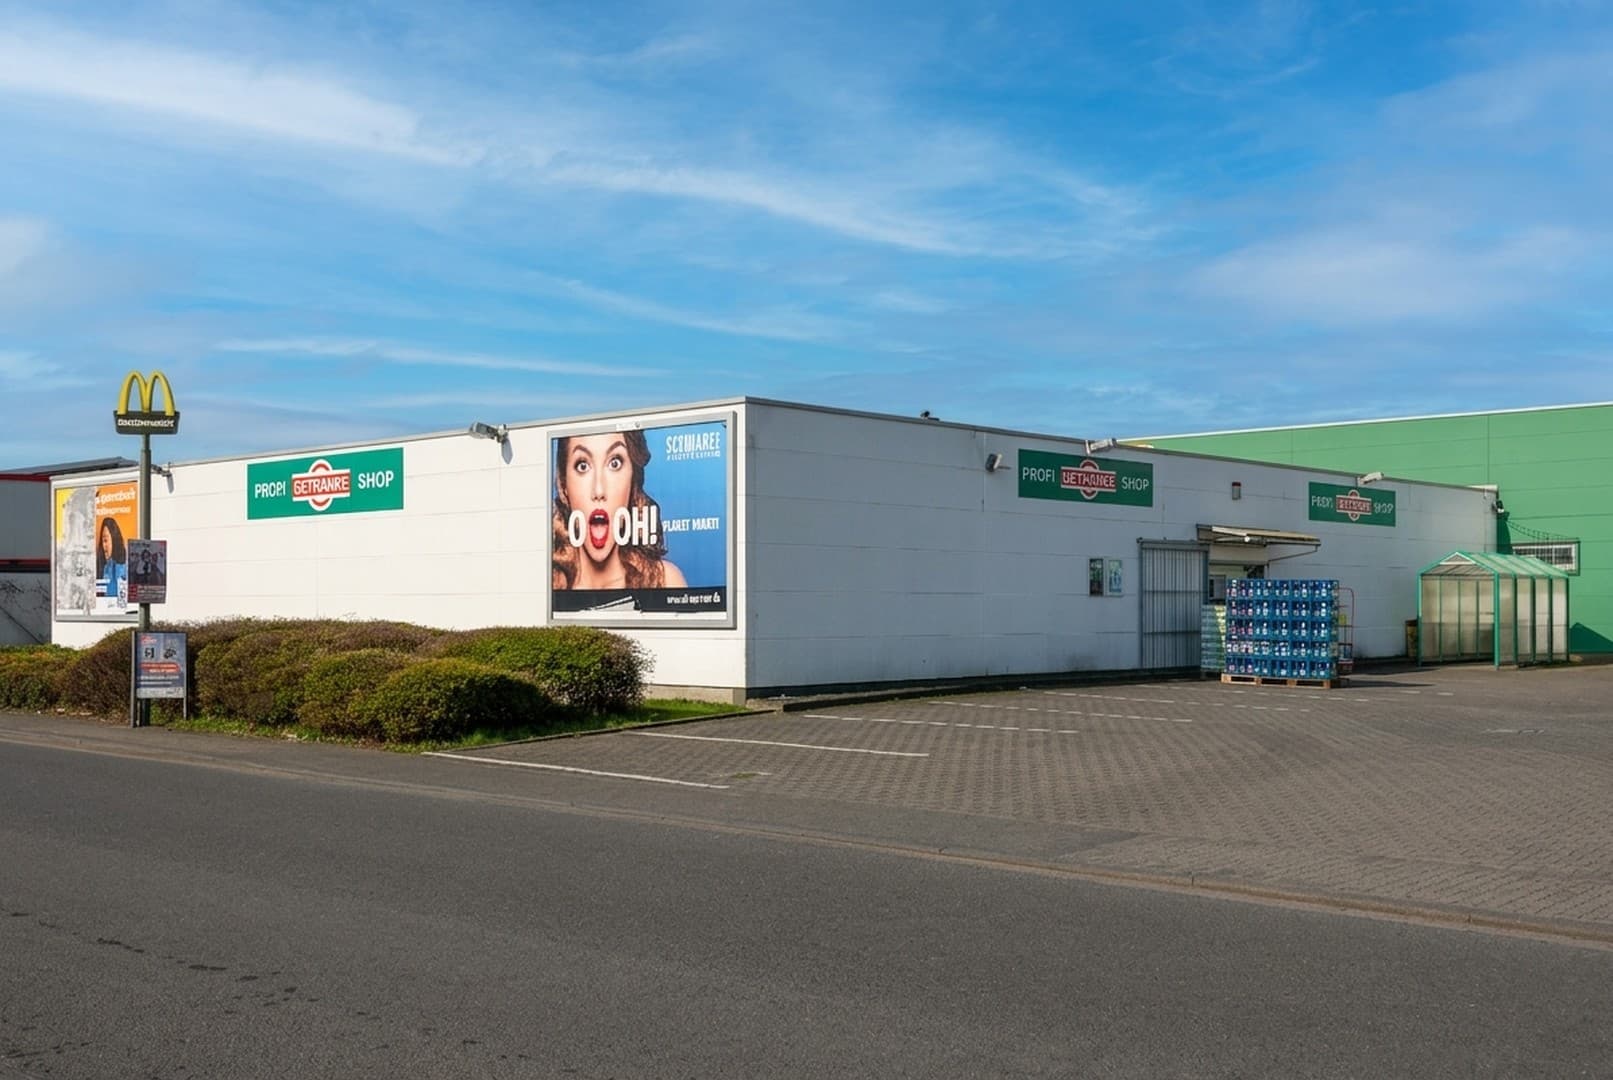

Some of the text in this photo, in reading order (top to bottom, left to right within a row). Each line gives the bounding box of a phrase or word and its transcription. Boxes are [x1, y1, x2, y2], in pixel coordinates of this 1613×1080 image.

[358, 470, 395, 490] SHOP
[1022, 466, 1055, 483] PROFI
[1121, 476, 1150, 491] SHOP
